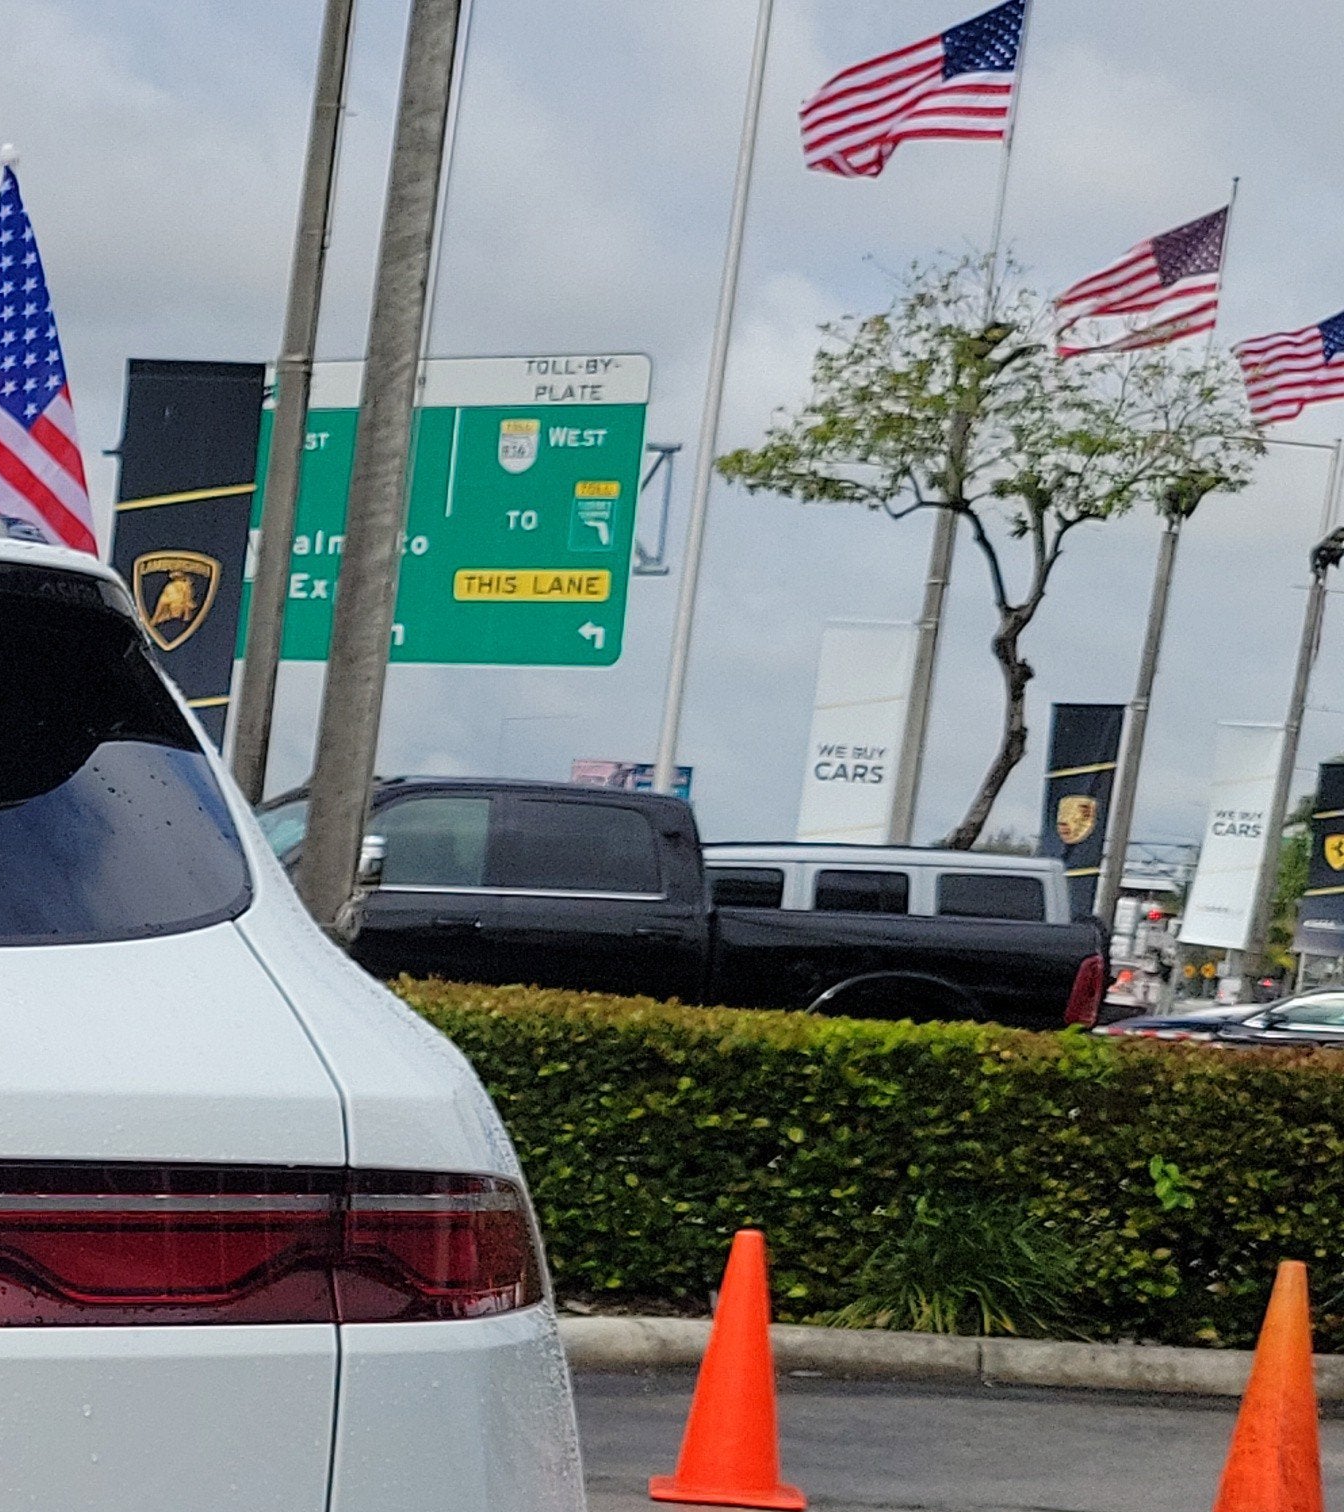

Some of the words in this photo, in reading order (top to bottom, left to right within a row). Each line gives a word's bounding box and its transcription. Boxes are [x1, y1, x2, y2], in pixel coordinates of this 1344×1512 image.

[534, 384, 603, 401] PLATE
[548, 426, 608, 447] WEST
[505, 509, 539, 531] TO
[464, 575, 518, 595] THIS
[532, 575, 601, 596] LANE
[818, 743, 848, 758] WE
[852, 745, 886, 760] BUY
[814, 761, 885, 784] CARS
[1213, 821, 1262, 838] CARS
